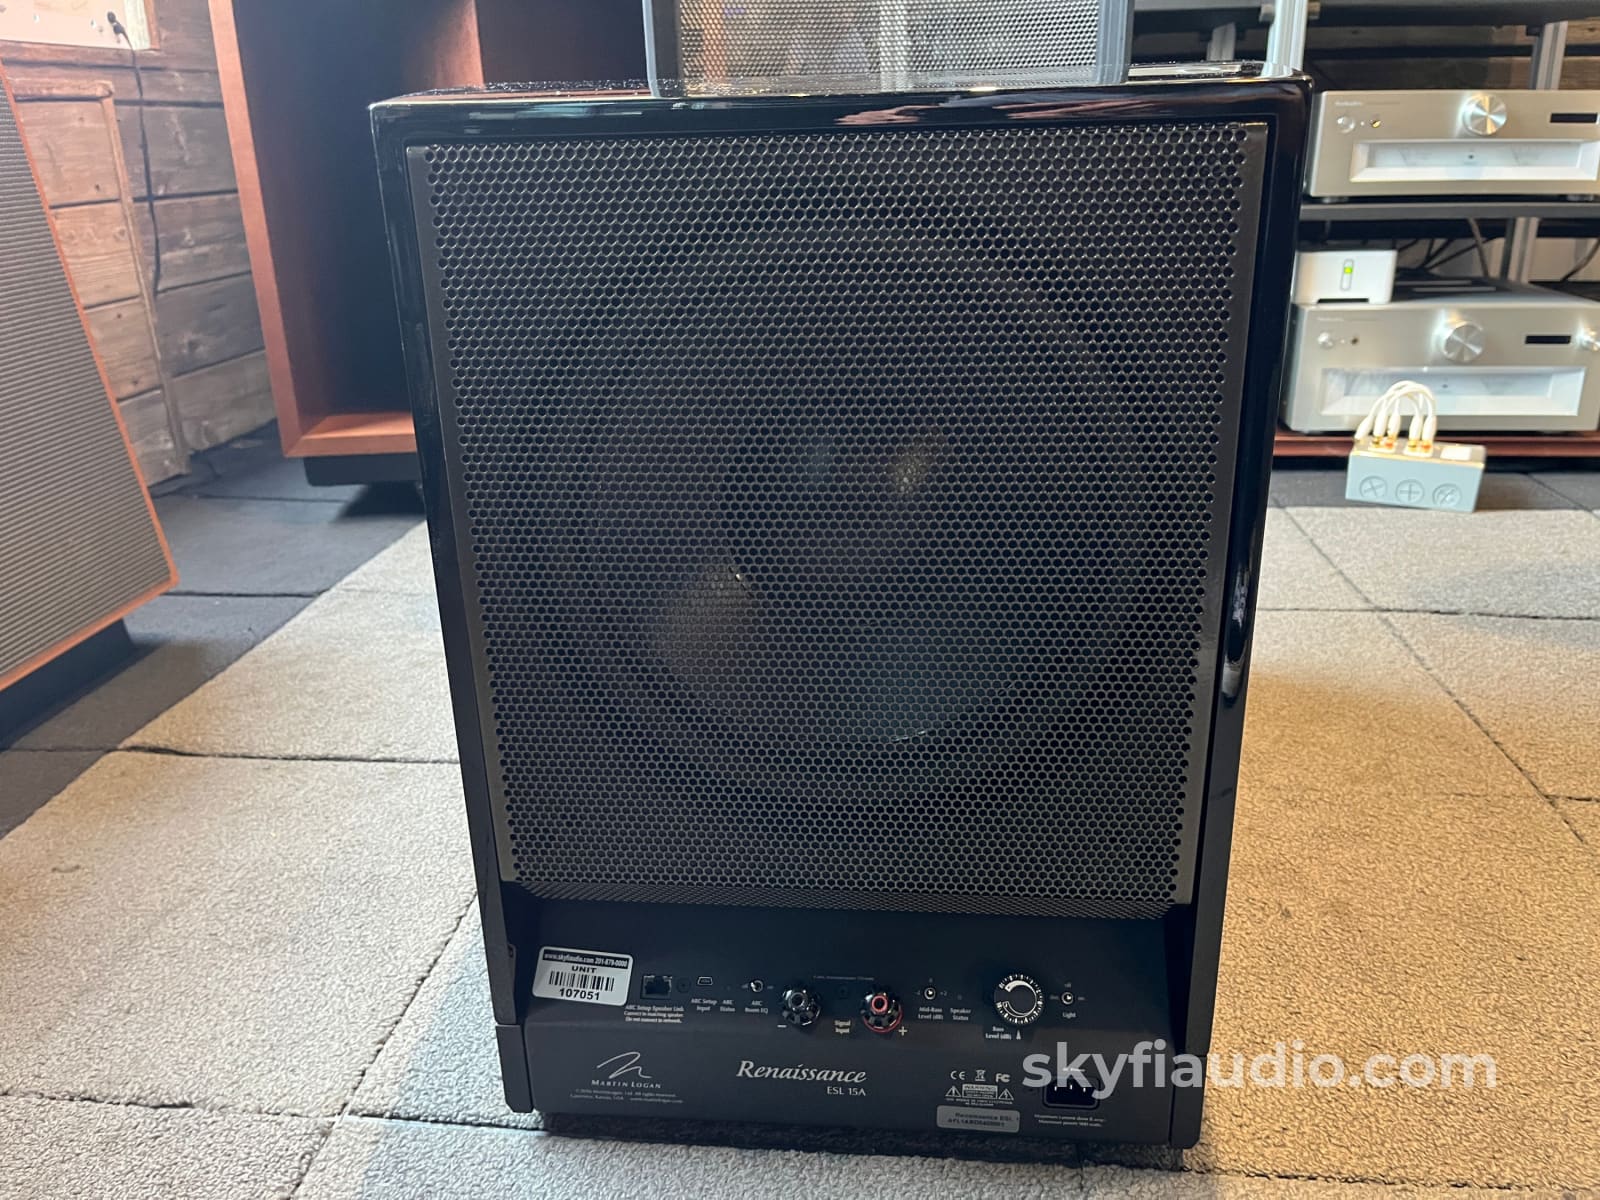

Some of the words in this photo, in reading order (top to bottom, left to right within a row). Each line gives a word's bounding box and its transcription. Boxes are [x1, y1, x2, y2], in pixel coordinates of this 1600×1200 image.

[571, 965, 597, 974] UNIT
[559, 987, 601, 1001] 107051
[735, 1059, 867, 1083] Renaissance
[591, 1079, 628, 1088] MARTIN
[631, 1081, 662, 1089] LOGAN
[826, 1085, 845, 1095] ESL
[847, 1087, 866, 1096] 15A
